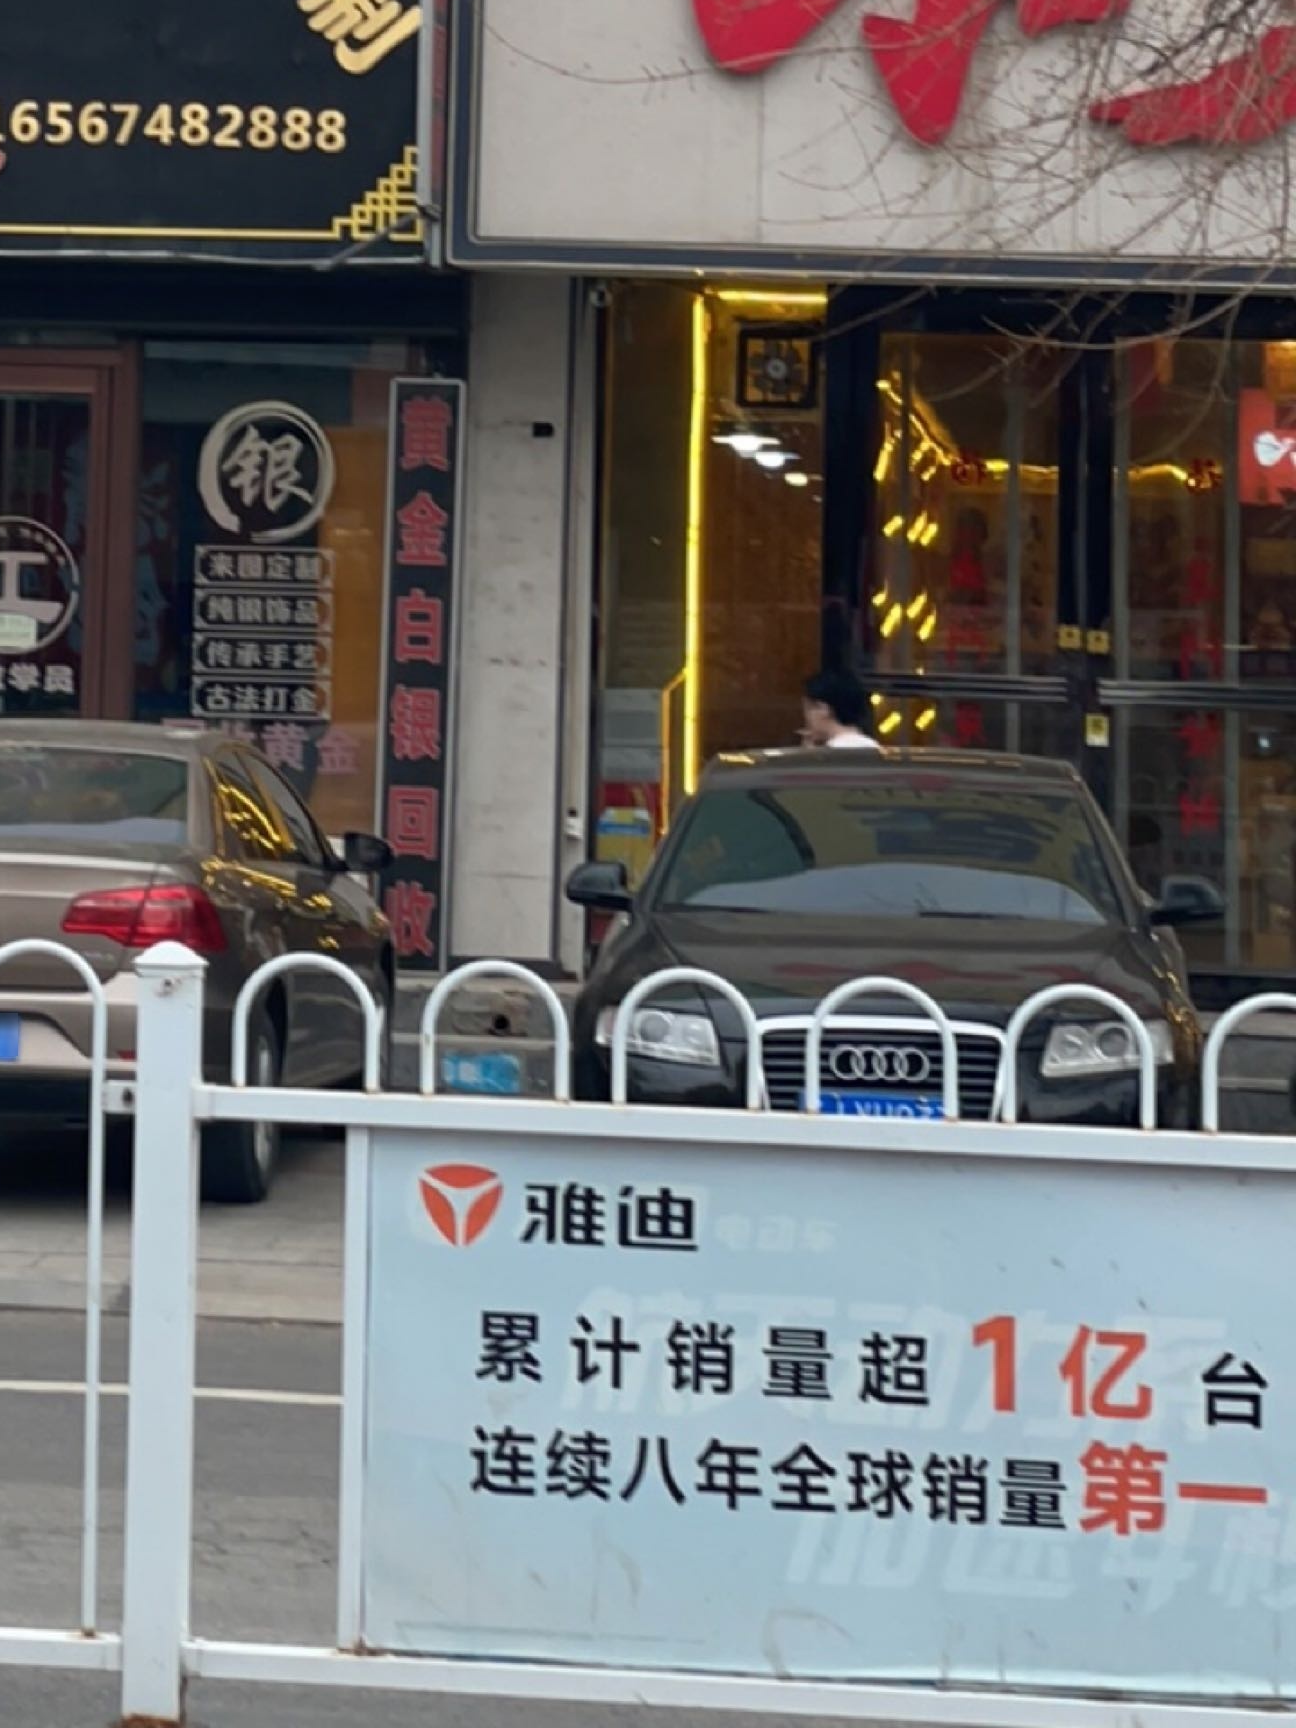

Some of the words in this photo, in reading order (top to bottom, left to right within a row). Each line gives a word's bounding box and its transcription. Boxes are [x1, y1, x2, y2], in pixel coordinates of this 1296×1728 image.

[221, 423, 315, 514] 银
[384, 394, 454, 958] 黄金白银回收
[520, 1180, 699, 1253] 雅迪
